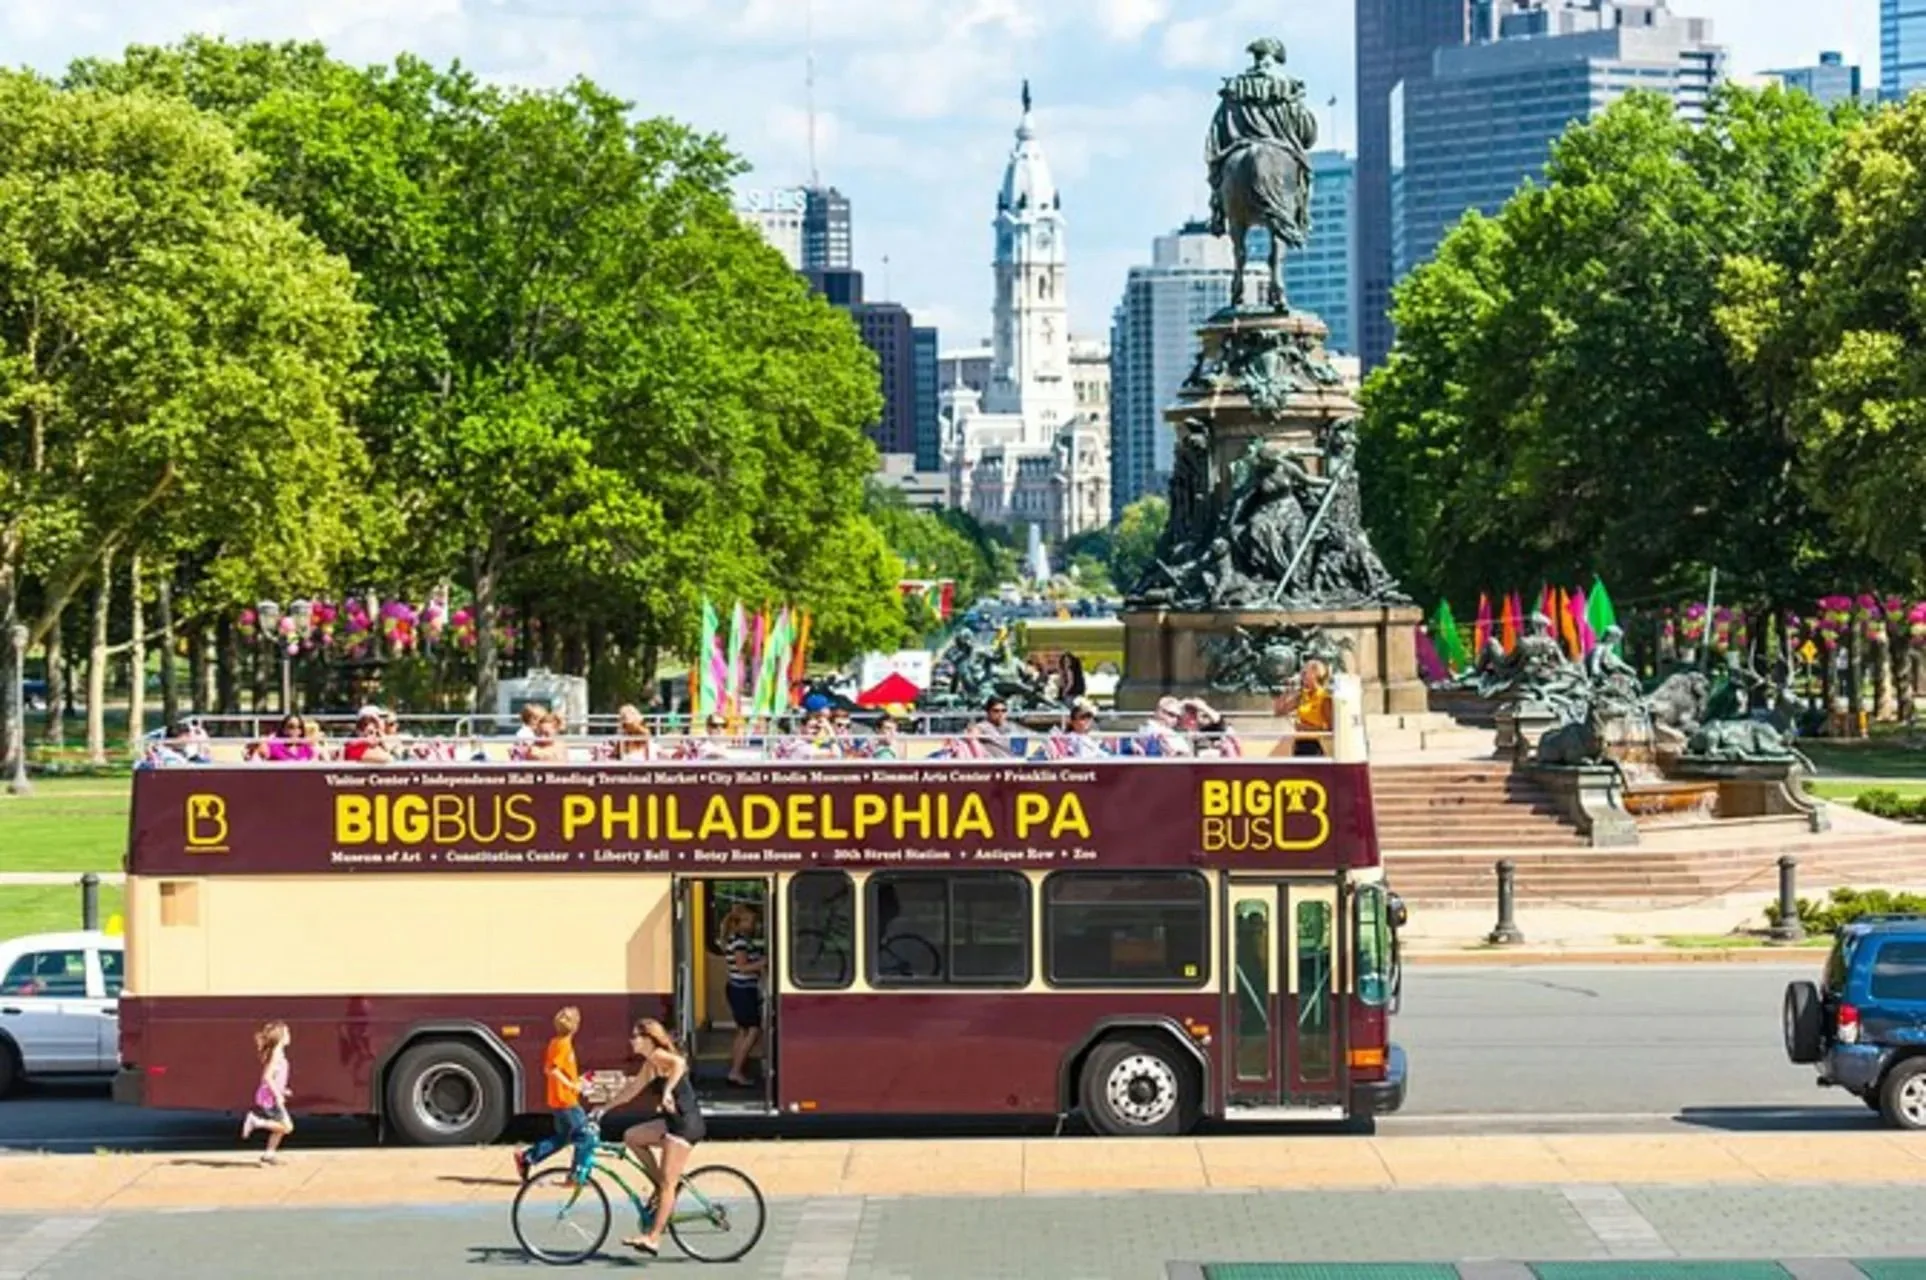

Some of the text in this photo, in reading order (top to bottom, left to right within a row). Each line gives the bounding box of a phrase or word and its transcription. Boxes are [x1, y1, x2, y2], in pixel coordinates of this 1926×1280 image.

[325, 770, 1096, 787] Visitor Center Independence Hall Reading Terminal Market City Hall Rodin Museum Kimmel Arts Center Franklin Court
[1203, 780, 1272, 816] BIG
[563, 793, 995, 841] PHILADELPHIA
[1016, 792, 1092, 840] PA
[1203, 817, 1272, 850] BUS
[331, 852, 382, 863] Museum
[385, 851, 399, 863] of
[400, 851, 421, 862] Art
[446, 850, 523, 863] Constitution
[526, 850, 569, 862] Center
[593, 850, 641, 864] Liberty
[644, 850, 669, 862] Bell
[694, 850, 728, 863] Betsy
[731, 850, 761, 861] Ross
[763, 850, 802, 861] House
[863, 849, 902, 860] Street
[905, 849, 951, 860] Station
[973, 849, 1024, 862] Antique
[1027, 849, 1055, 860] Row
[1073, 848, 1097, 859] Zoo
